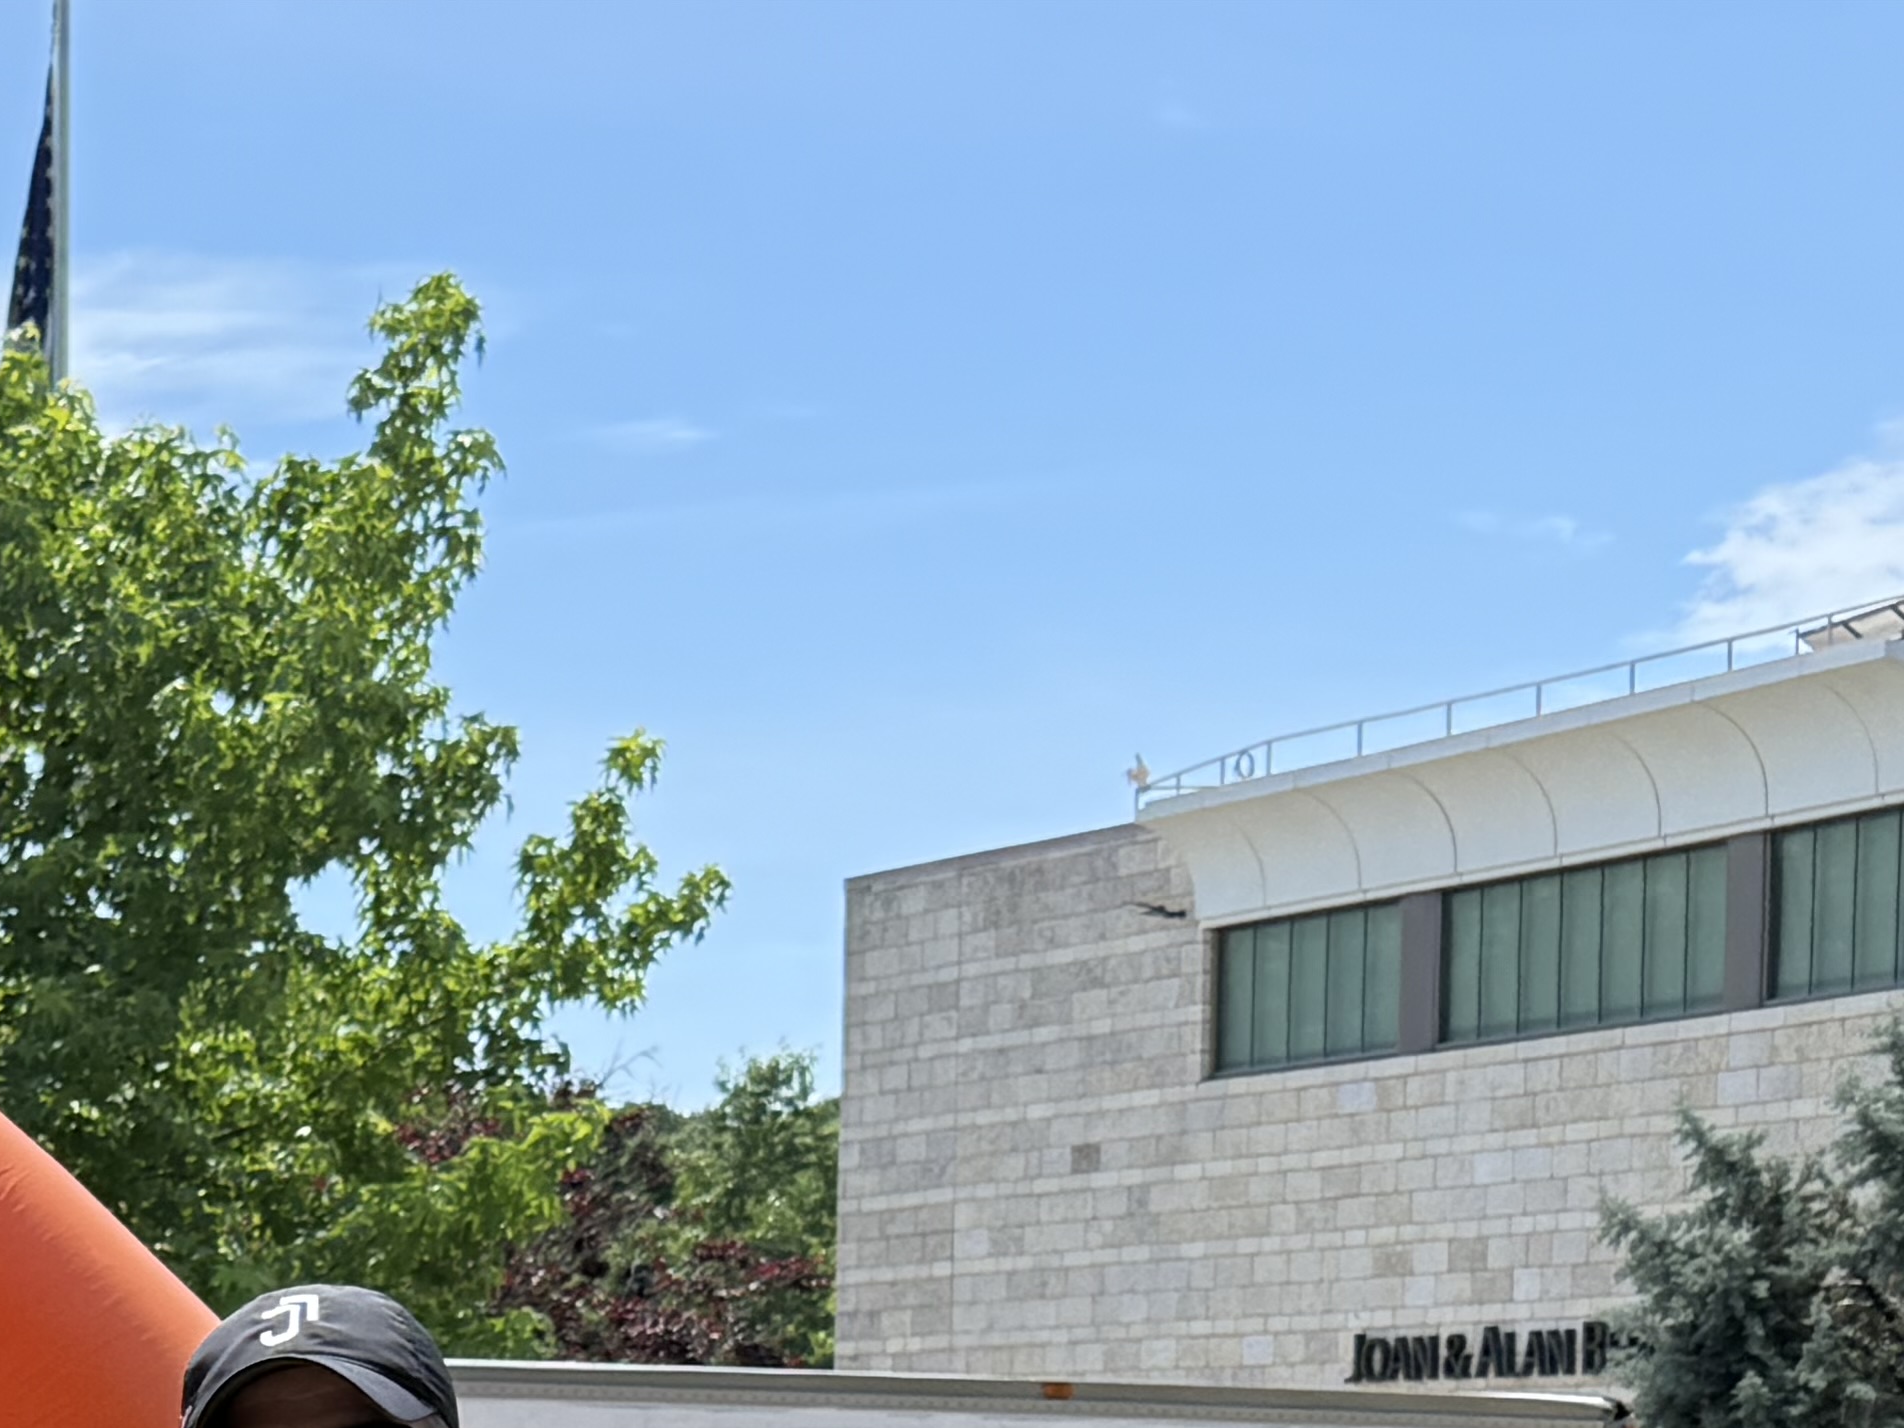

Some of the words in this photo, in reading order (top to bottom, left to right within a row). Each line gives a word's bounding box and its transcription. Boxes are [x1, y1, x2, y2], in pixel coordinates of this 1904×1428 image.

[1344, 1334, 1440, 1384] JOAN
[1443, 1334, 1473, 1379] &
[1474, 1325, 1578, 1379] ALAN
